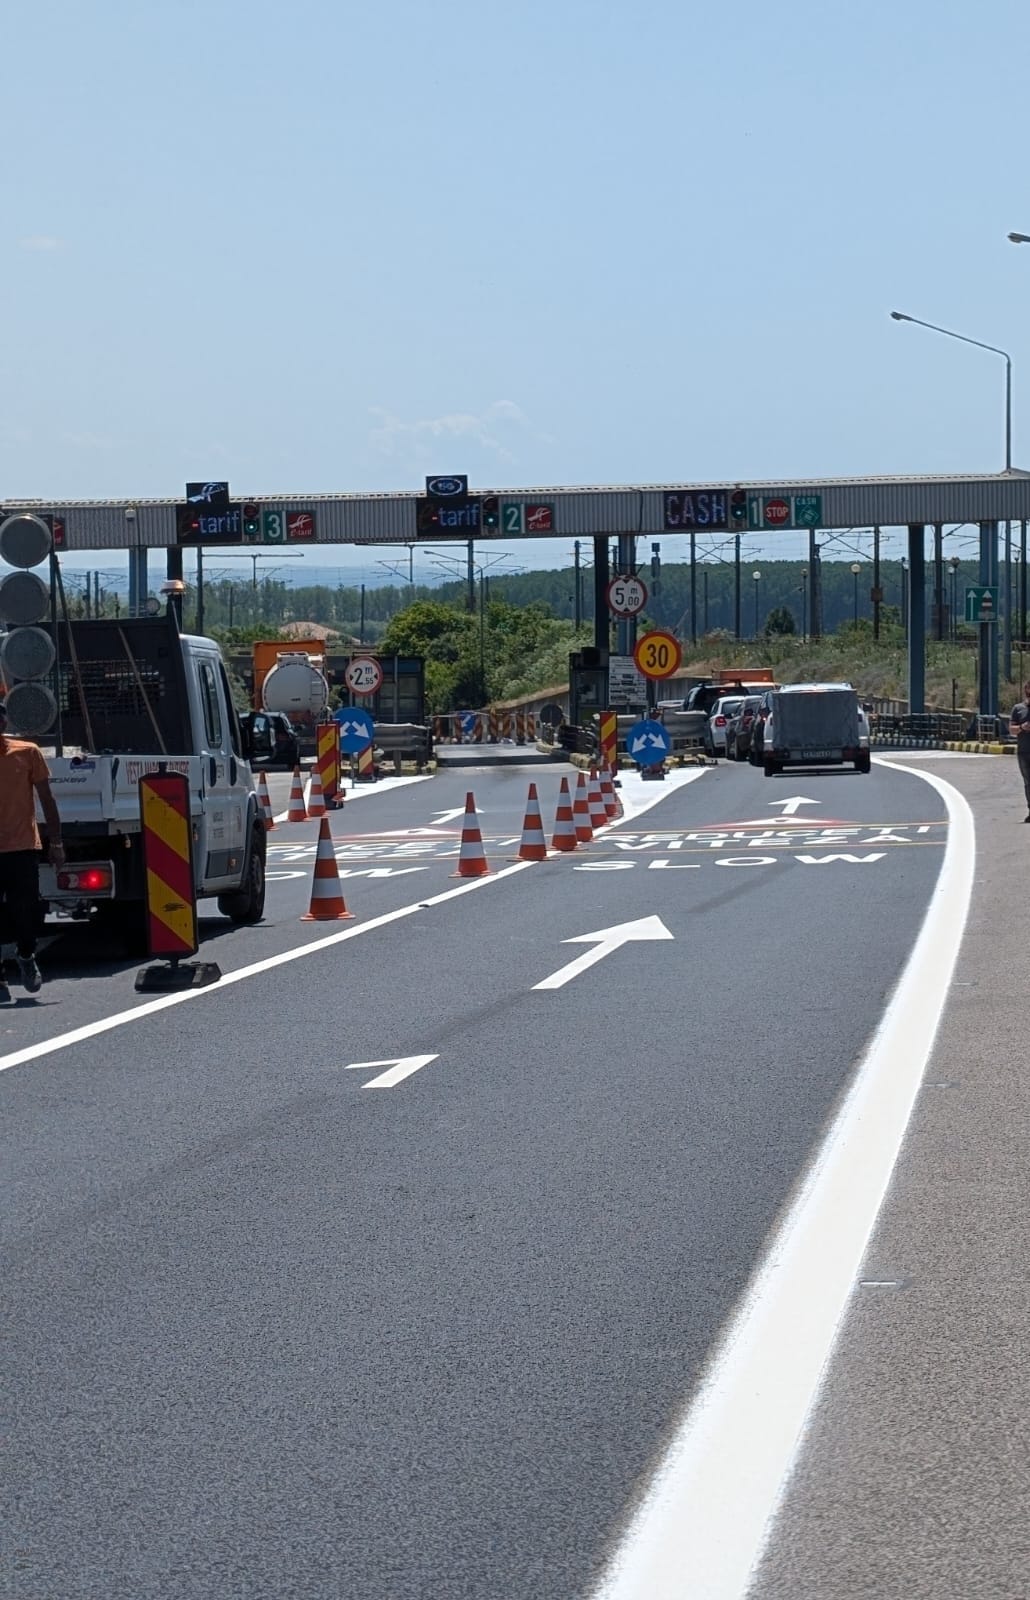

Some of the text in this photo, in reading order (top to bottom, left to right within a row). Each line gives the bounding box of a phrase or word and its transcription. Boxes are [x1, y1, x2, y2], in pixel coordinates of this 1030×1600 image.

[666, 494, 726, 525] CASH
[751, 501, 758, 525] 1
[765, 506, 789, 518] STOP
[796, 497, 817, 505] CASH
[268, 514, 281, 538] 3
[506, 507, 519, 532] 2
[646, 643, 669, 669] 30
[616, 835, 914, 850] VITEZA
[573, 852, 887, 870] SLOW
